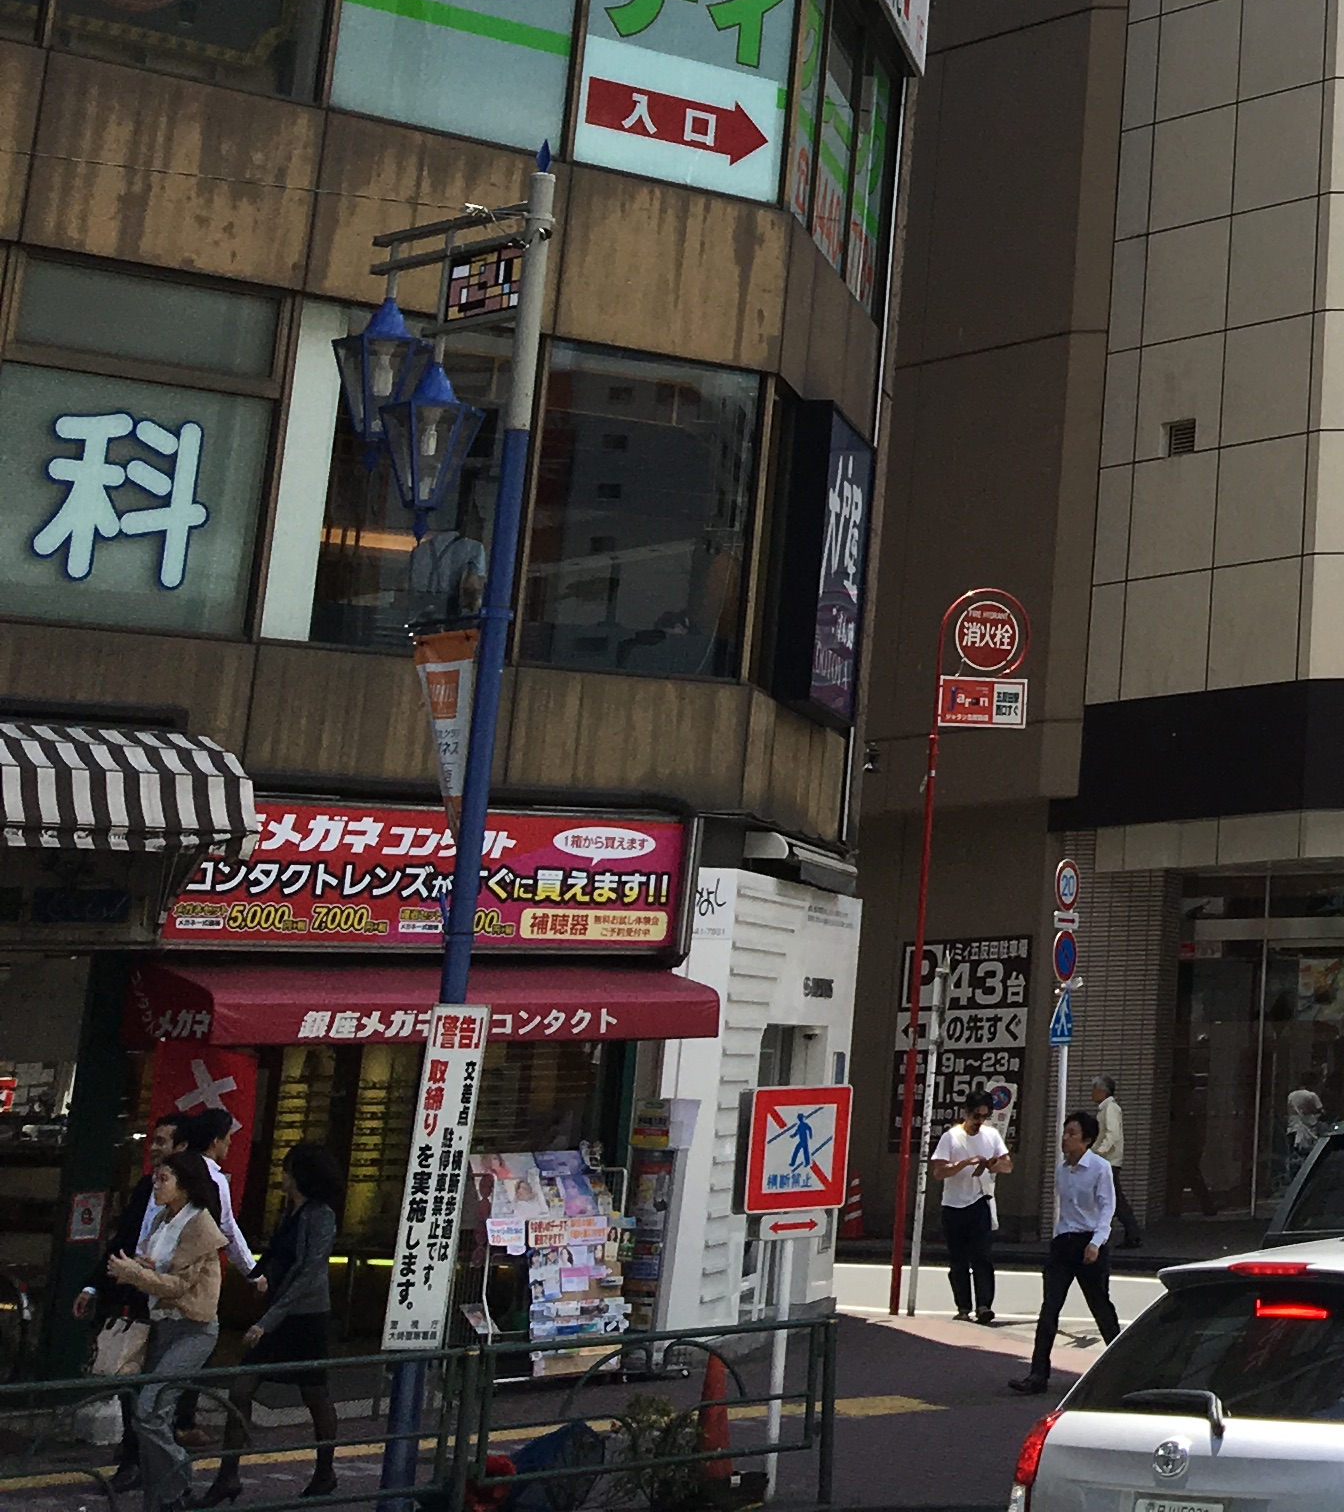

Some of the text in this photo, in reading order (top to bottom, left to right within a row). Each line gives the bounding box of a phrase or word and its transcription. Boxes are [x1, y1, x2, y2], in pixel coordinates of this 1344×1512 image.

[621, 92, 718, 150] 入口
[32, 411, 209, 591] 科
[961, 621, 1014, 650] 消火栓
[563, 834, 650, 852] 1箱から買えます
[185, 861, 669, 904] コンタクトレンズがぐに買えます!!
[1060, 873, 1076, 898] 20
[529, 912, 590, 937] 補聴器
[948, 960, 1026, 1007] 43台
[490, 1006, 620, 1036] コンタクト
[766, 1172, 813, 1190] 横断禁止
